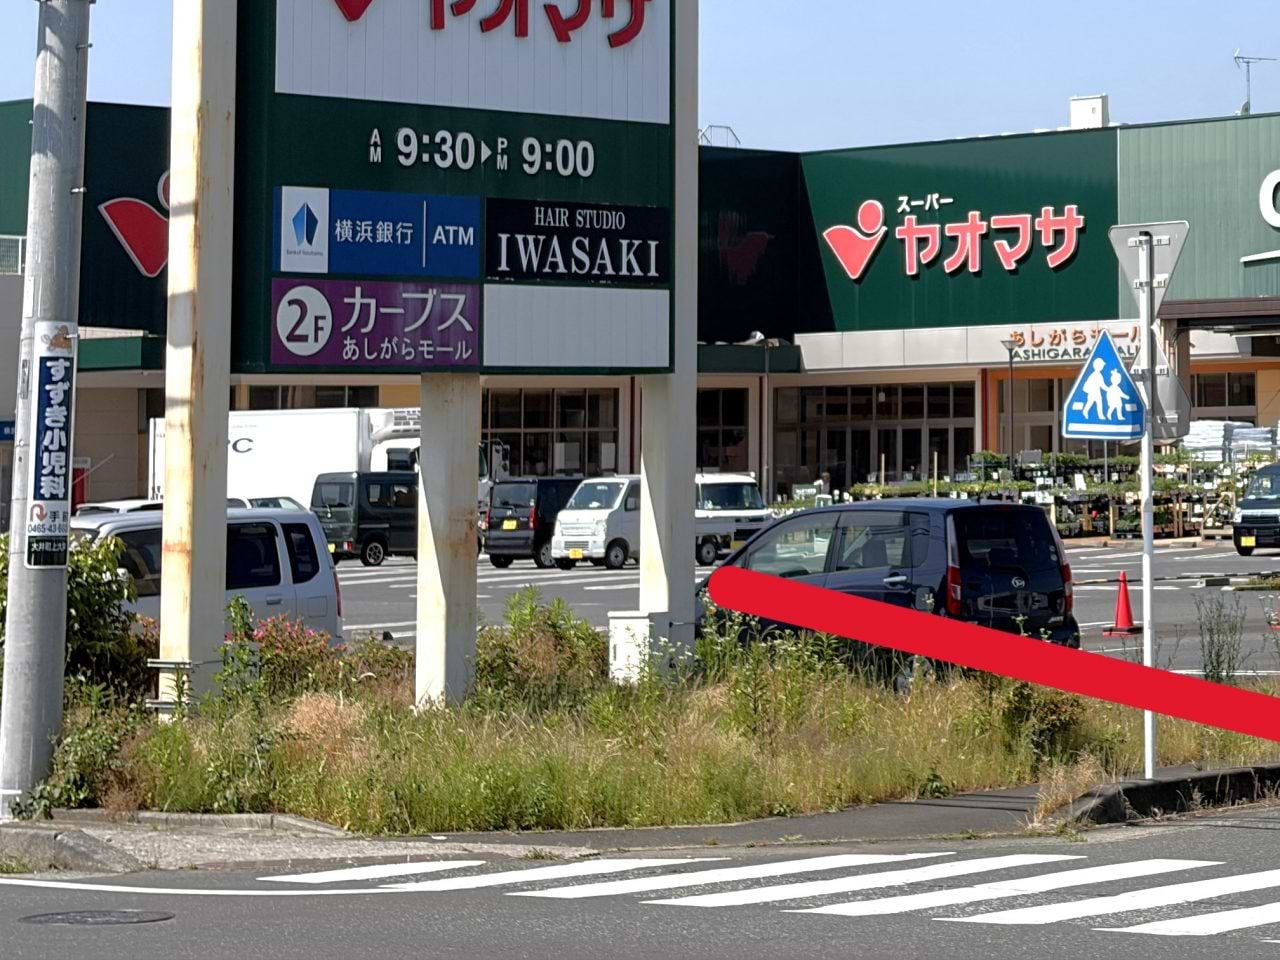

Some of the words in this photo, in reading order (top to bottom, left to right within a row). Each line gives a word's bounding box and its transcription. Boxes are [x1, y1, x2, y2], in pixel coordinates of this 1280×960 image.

[397, 127, 475, 170] 9:30
[522, 137, 594, 177] 9:00
[535, 206, 569, 227] HAIR
[575, 210, 625, 230] STUDIO
[897, 193, 954, 213] スーパー
[335, 219, 414, 244] 横浜銀行
[433, 225, 474, 246] ATM
[896, 205, 1084, 276] ヤオマサ
[497, 233, 660, 277] IWASAKI
[286, 298, 326, 343] 2F
[341, 286, 473, 333] カーブス
[342, 336, 472, 360] あしがらモール
[1013, 347, 1091, 360] ASHIGARA
[40, 358, 70, 498] すずき小児科
